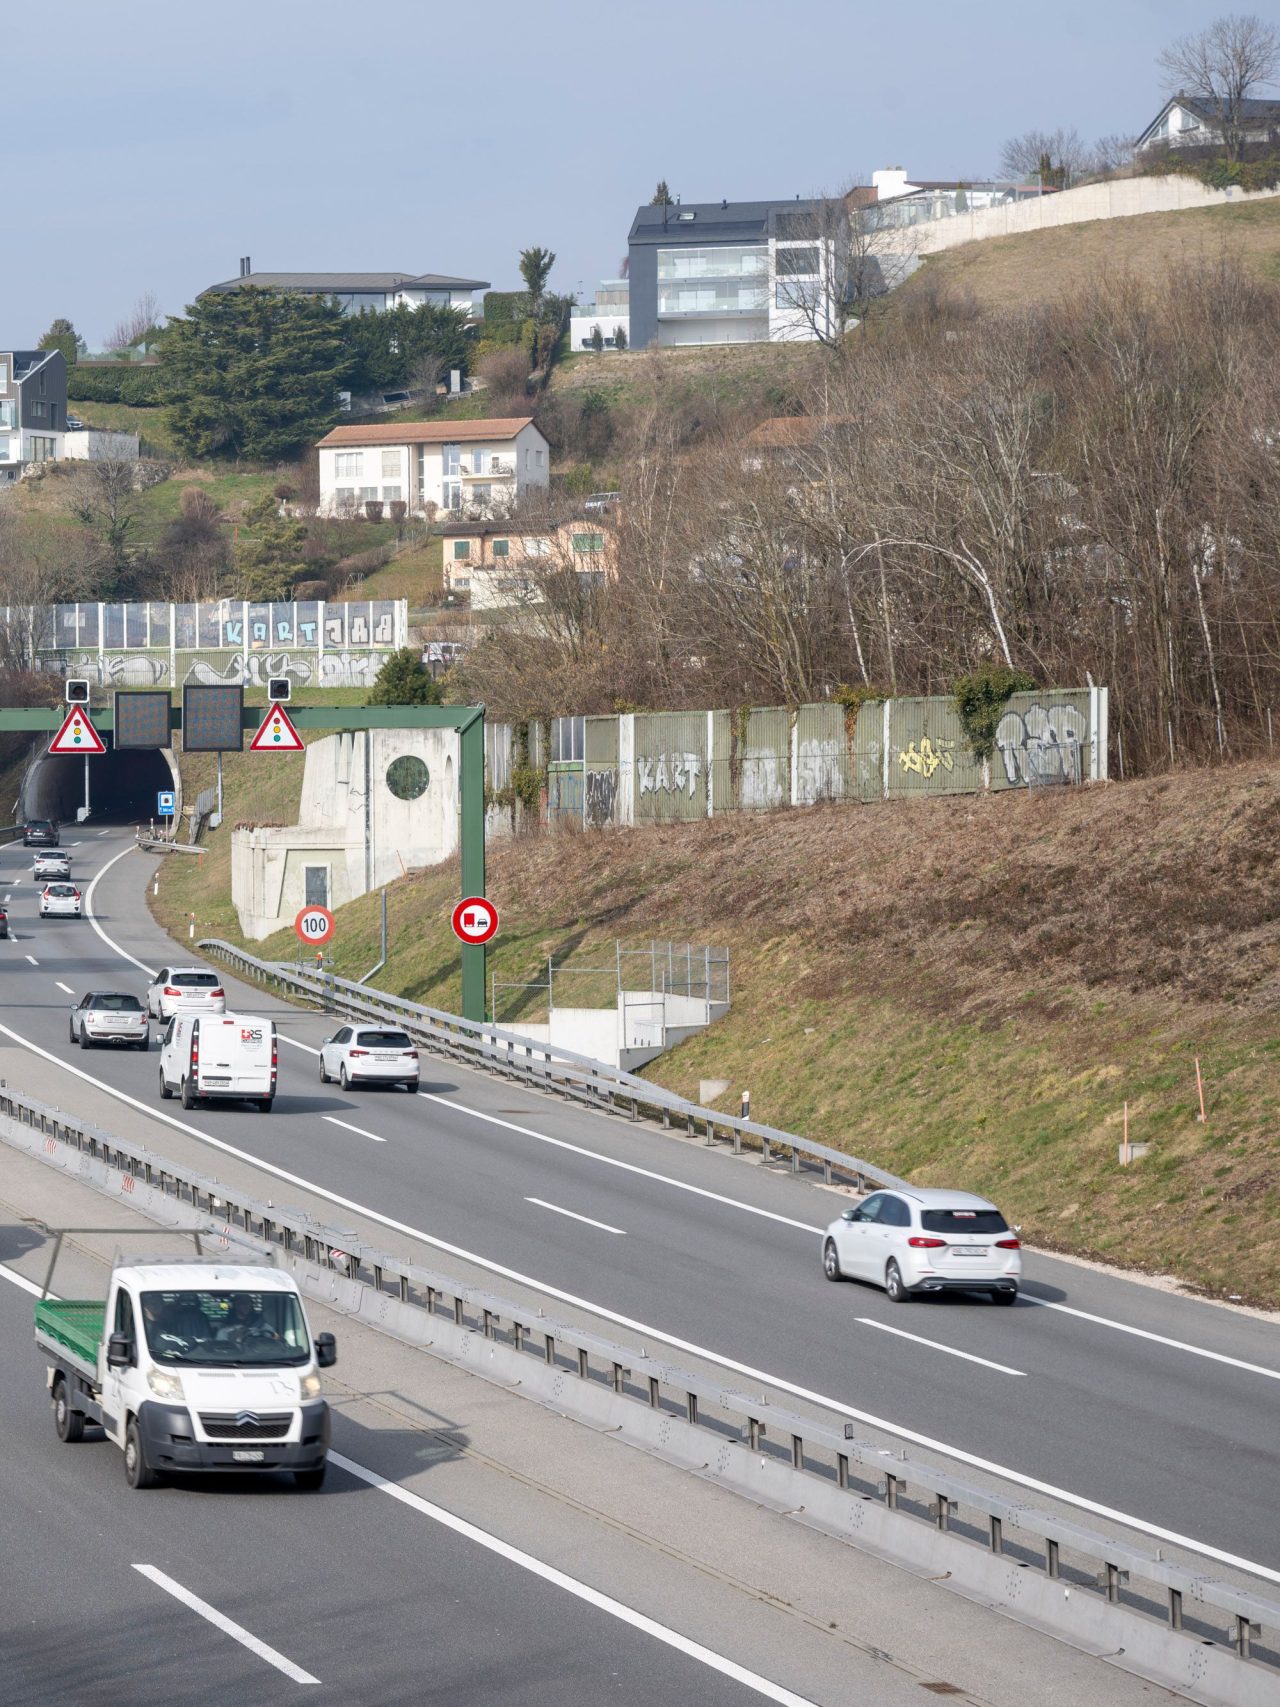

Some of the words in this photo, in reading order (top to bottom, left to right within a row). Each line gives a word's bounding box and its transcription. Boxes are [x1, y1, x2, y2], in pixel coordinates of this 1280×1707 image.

[225, 621, 317, 644] KART
[636, 751, 702, 800] KART
[304, 918, 326, 932] 100
